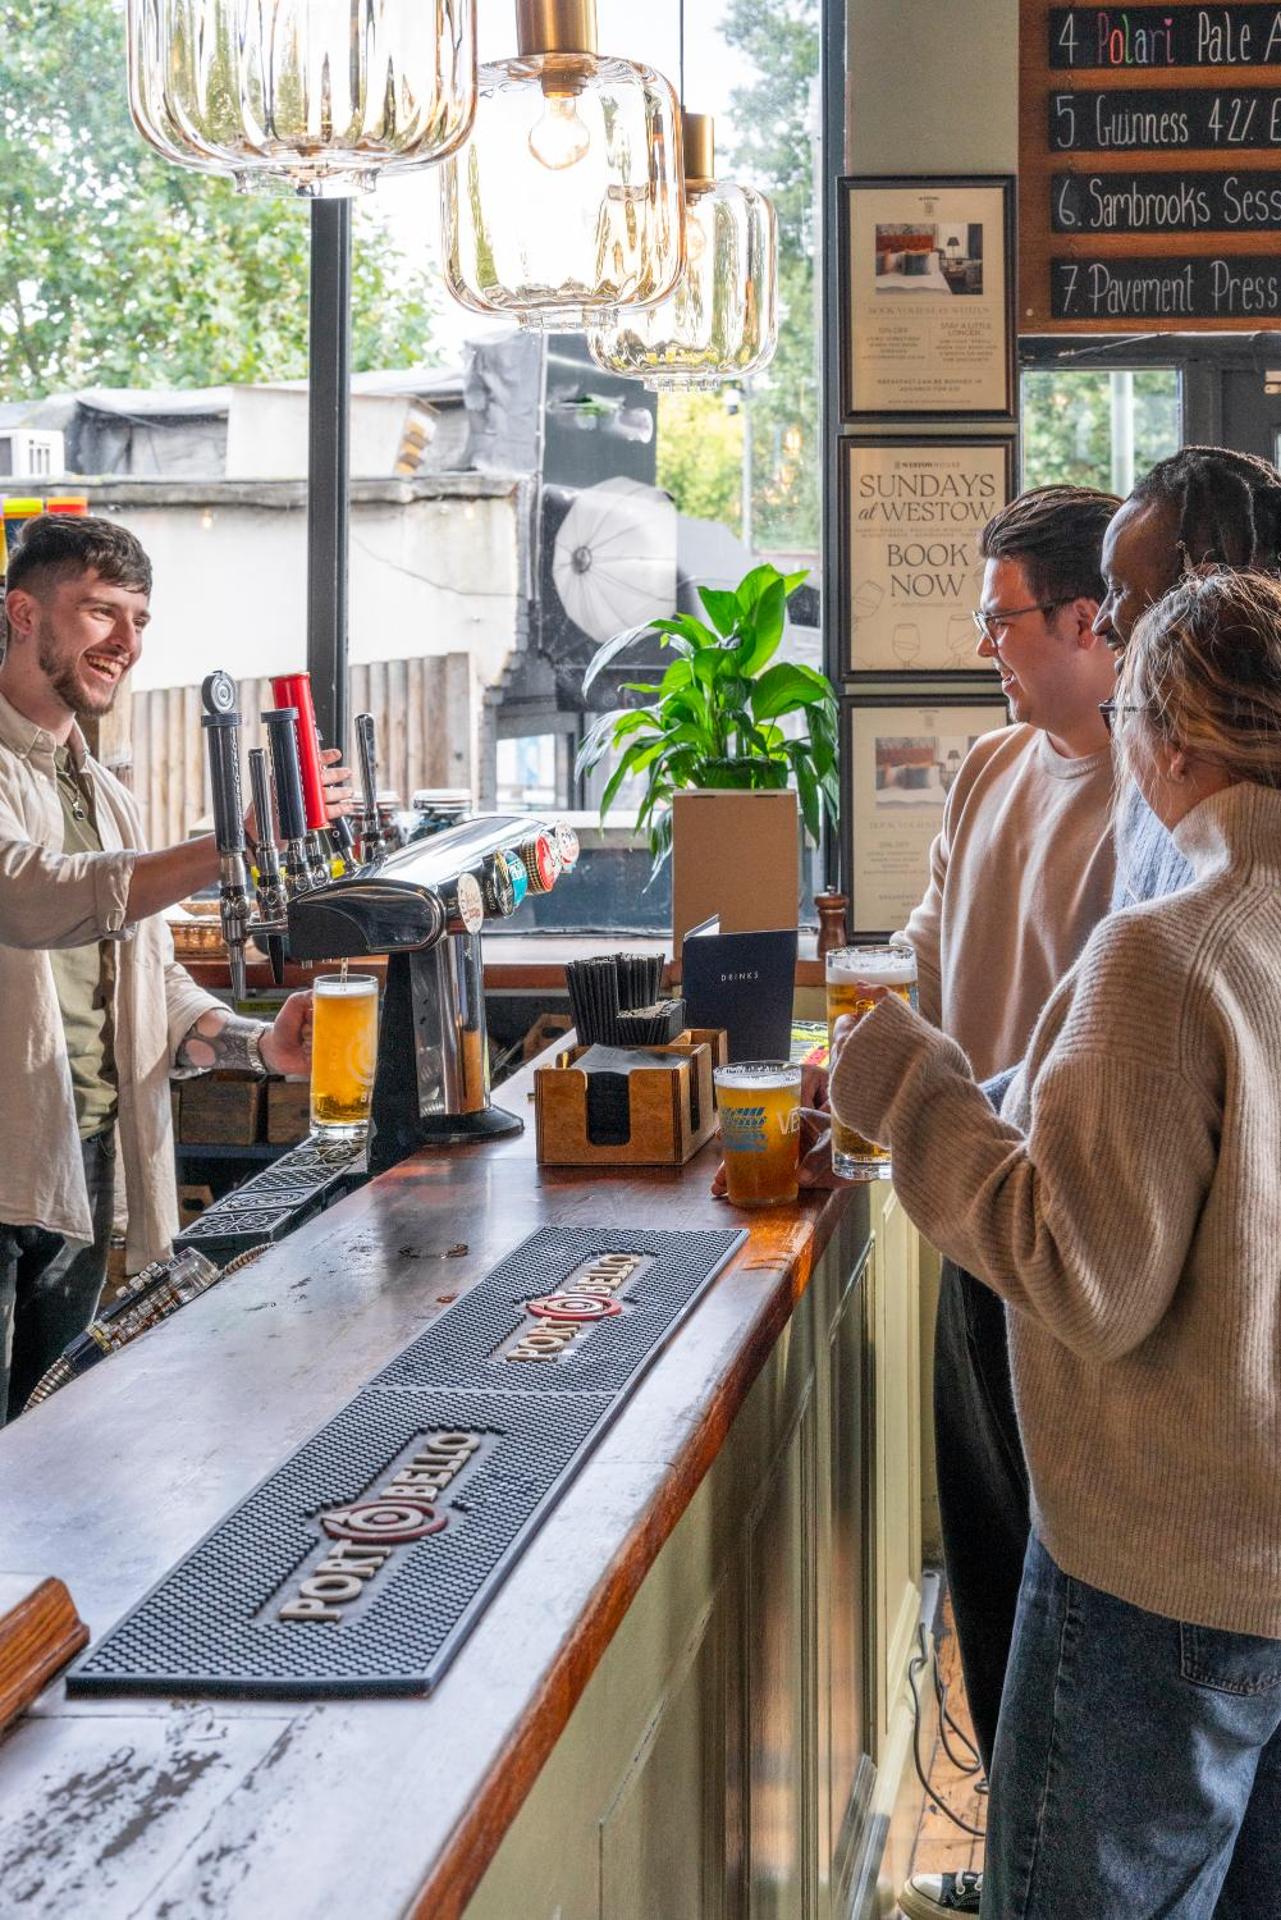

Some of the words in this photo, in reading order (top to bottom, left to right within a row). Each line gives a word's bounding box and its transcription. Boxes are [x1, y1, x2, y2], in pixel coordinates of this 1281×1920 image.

[1058, 13, 1079, 64] 4
[1097, 12, 1175, 64] Polari
[1198, 11, 1251, 63] Pale
[1096, 95, 1189, 146] Guinness
[1089, 178, 1211, 228] Sambrooks
[1088, 263, 1194, 313] Pavement
[1210, 260, 1278, 311] Press
[859, 474, 996, 498] SUNDAYS
[858, 502, 879, 521] at
[880, 501, 996, 522] WESTOW
[887, 543, 970, 568] BOOK
[890, 573, 966, 598] NOW
[720, 970, 760, 982] DRINKS
